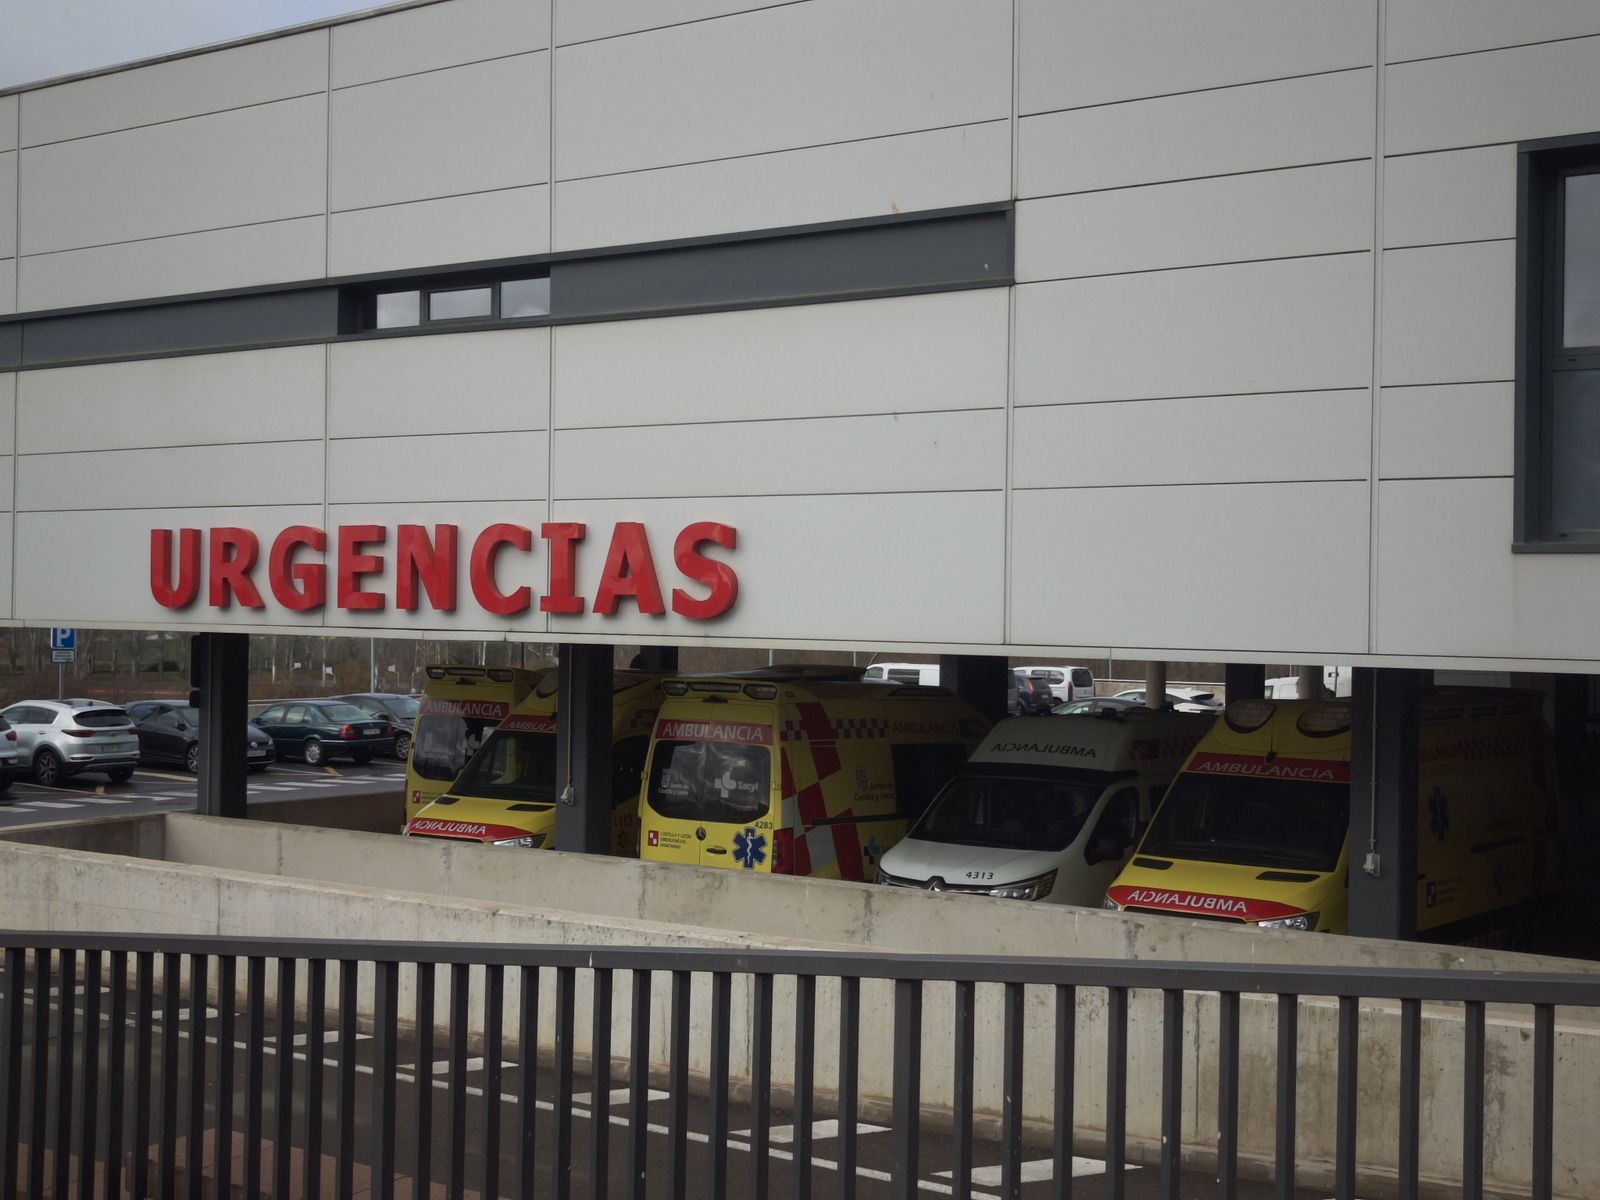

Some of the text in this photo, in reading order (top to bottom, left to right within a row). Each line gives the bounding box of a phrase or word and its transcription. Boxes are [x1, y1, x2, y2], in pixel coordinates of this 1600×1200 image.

[150, 521, 740, 620] URGENCIAS
[56, 627, 71, 647] P
[424, 701, 502, 717] AMBULANCIA
[506, 720, 557, 731] AMBULA
[662, 722, 763, 741] AMBULANCIA
[1199, 761, 1335, 780] AMBULANCIA
[754, 820, 773, 830] 4283
[966, 871, 994, 881] 4313
